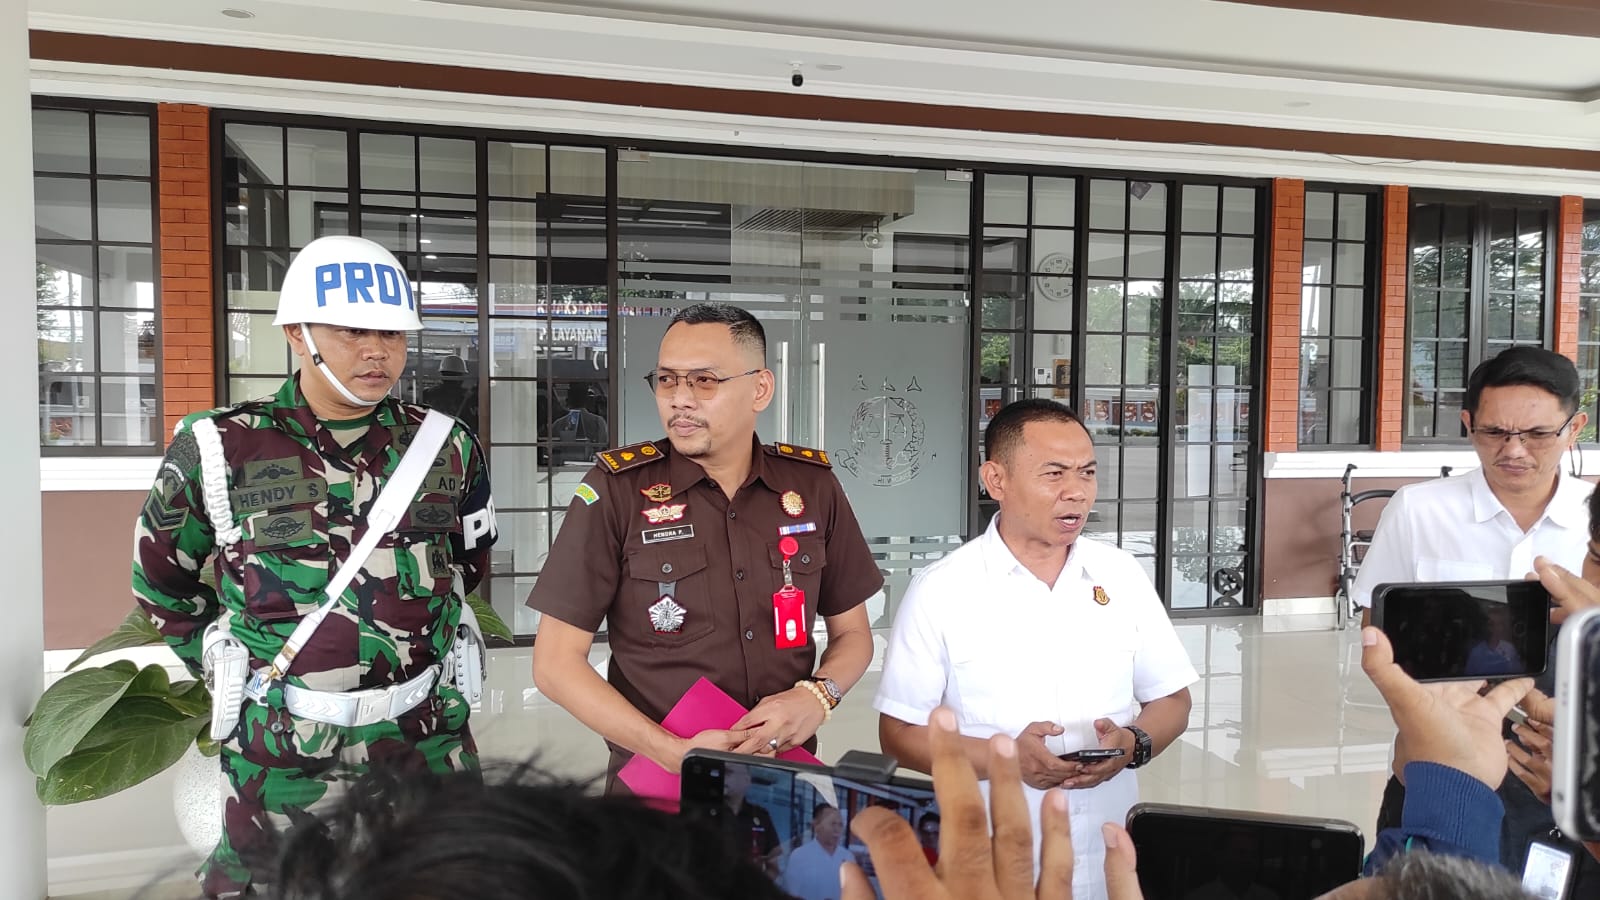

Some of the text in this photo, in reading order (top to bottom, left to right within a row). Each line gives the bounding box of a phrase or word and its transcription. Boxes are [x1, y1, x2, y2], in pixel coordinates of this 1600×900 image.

[538, 327, 600, 342] PLAYANAN
[438, 477, 456, 491] AD
[239, 483, 319, 508] HENDY S
